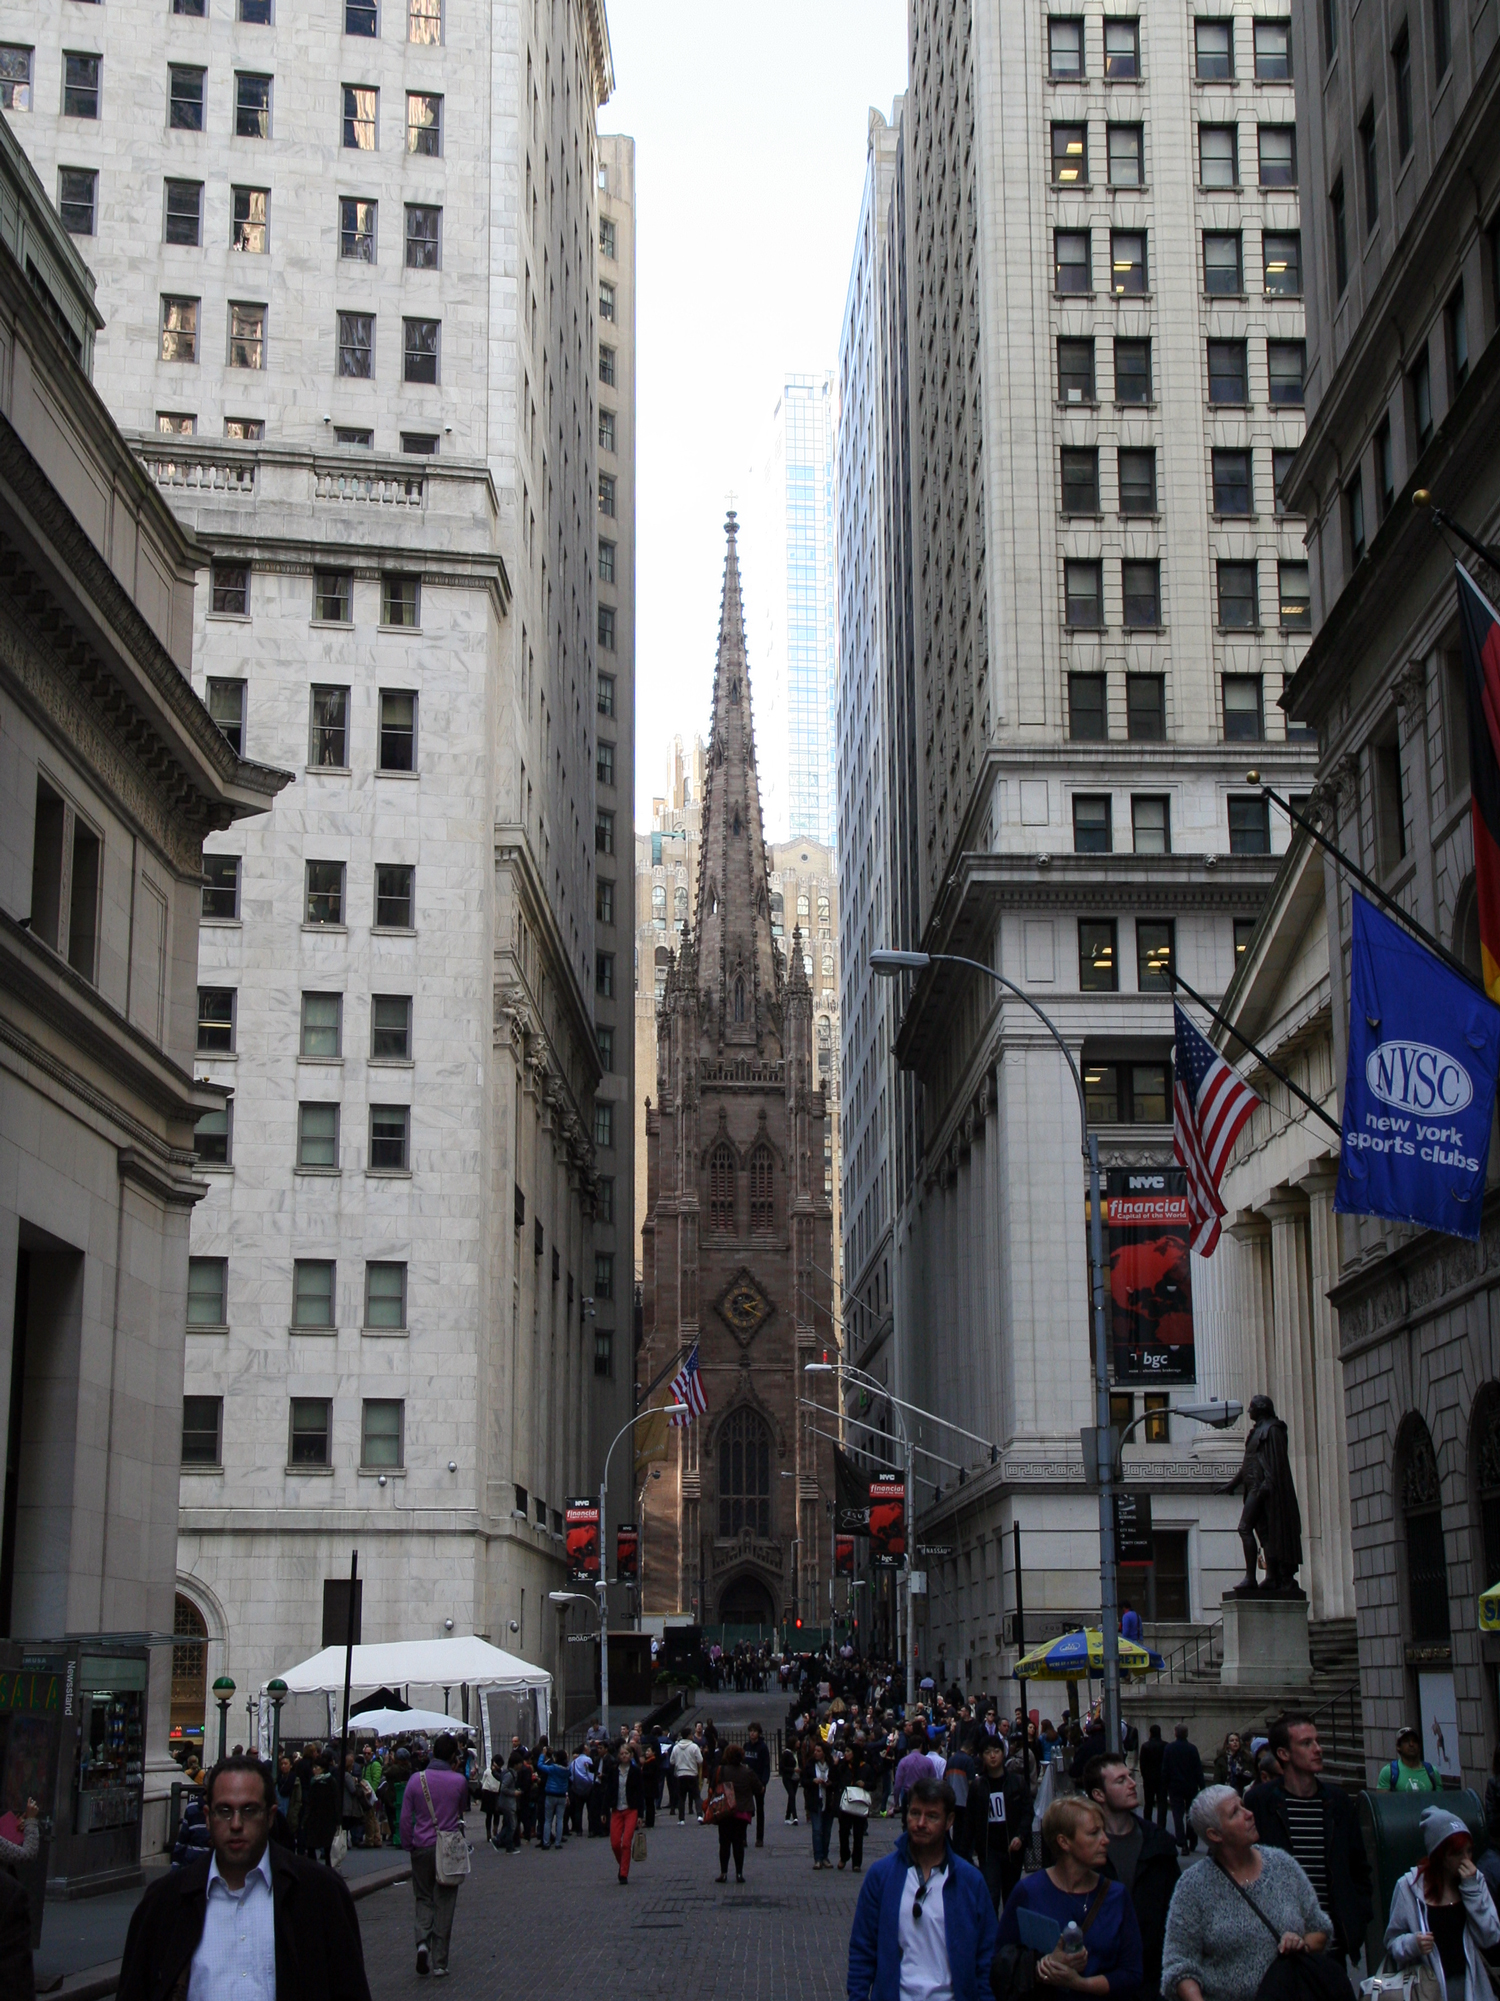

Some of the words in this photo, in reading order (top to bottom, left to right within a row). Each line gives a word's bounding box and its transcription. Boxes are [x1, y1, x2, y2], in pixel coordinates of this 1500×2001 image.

[1376, 1046, 1460, 1109] NYSC
[1366, 1112, 1411, 1133] new
[1415, 1123, 1464, 1147] york
[1346, 1131, 1416, 1156] sports
[1420, 1145, 1480, 1172] clubs
[1129, 1176, 1165, 1189] NYC
[1110, 1199, 1186, 1217] financial
[1143, 1351, 1169, 1369] bgc
[879, 1473, 896, 1481] NYC
[870, 1484, 904, 1493] financial
[567, 1510, 598, 1518] financial
[926, 1547, 948, 1555] NASSAU
[65, 1660, 76, 1716] Newsstand
